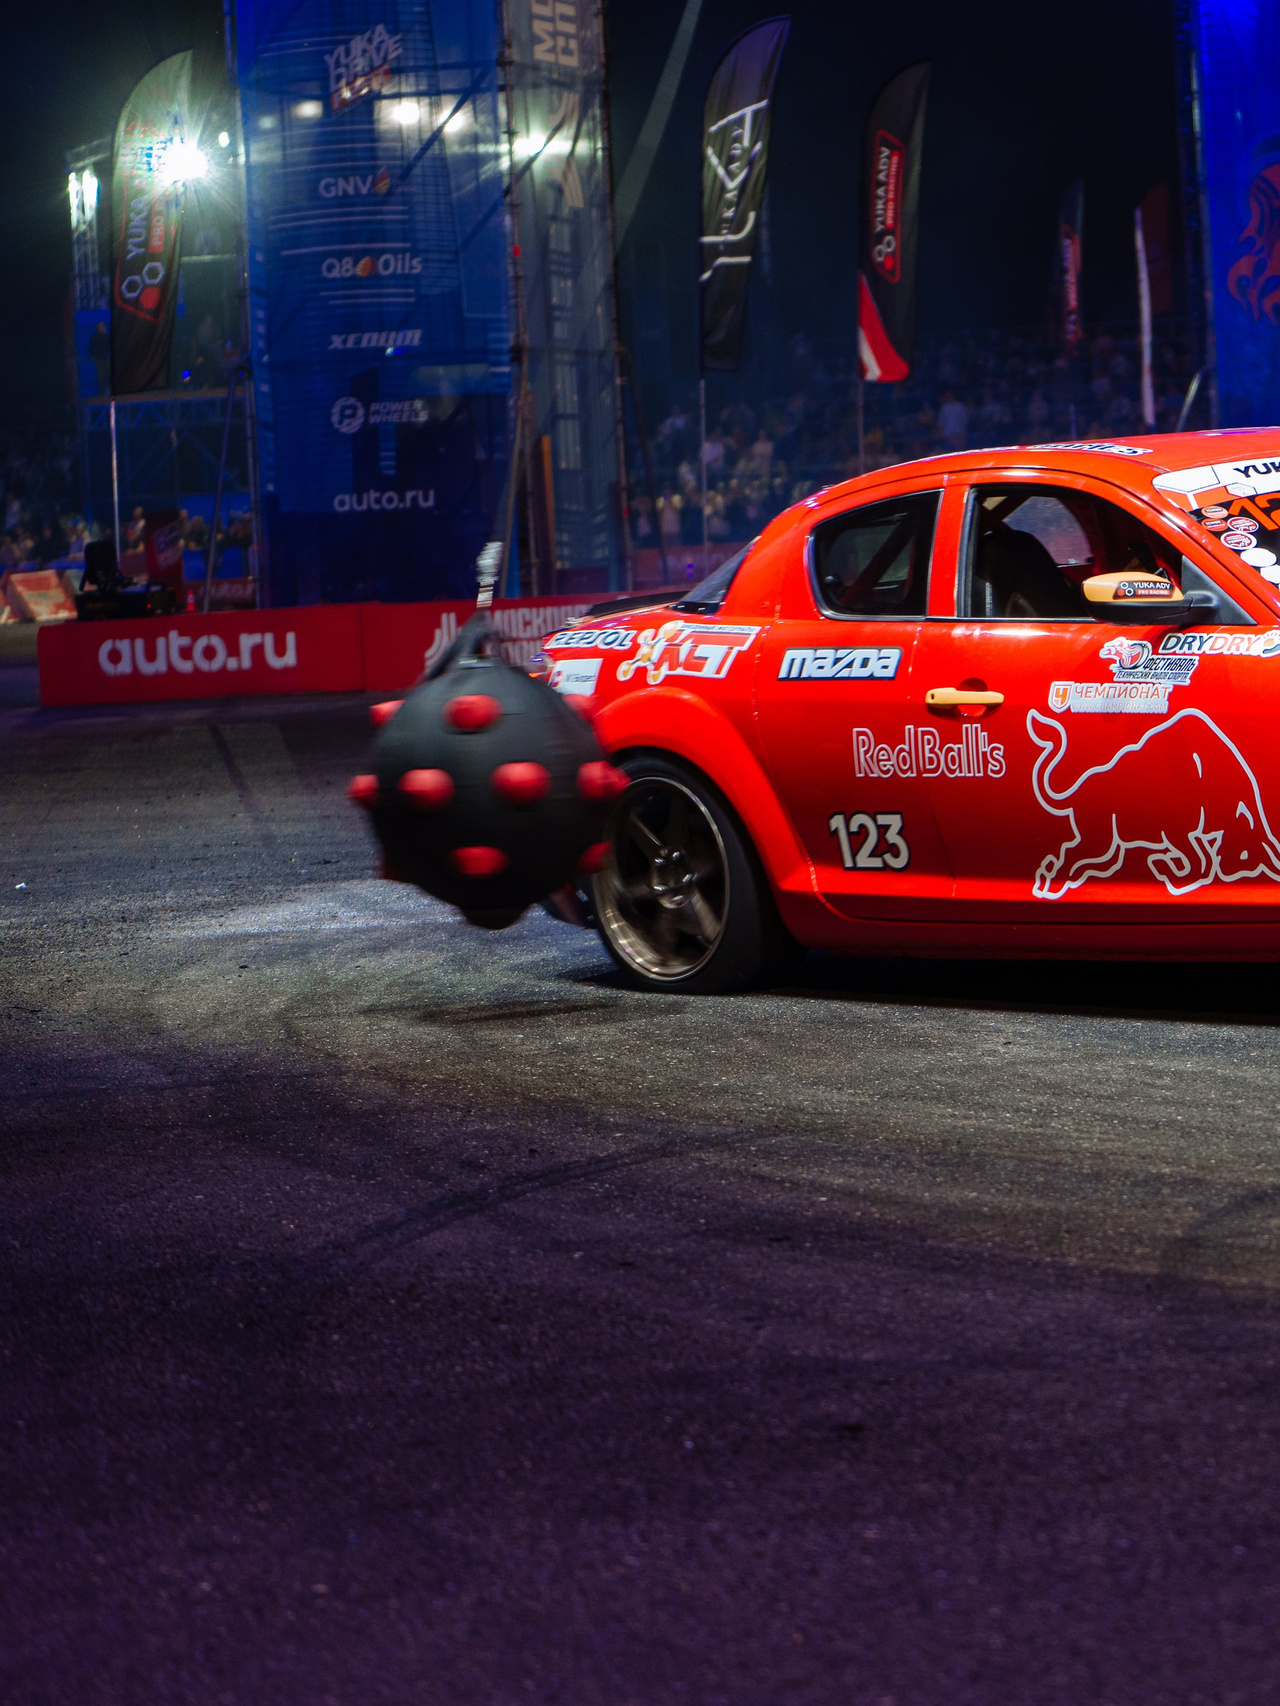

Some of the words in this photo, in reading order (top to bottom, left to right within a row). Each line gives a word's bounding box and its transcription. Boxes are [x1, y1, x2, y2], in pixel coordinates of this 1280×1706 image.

[877, 146, 891, 183] ADV
[318, 175, 374, 198] GNV
[874, 185, 887, 232] YUKA
[370, 400, 424, 412] POWER
[369, 410, 429, 424] WHEELS
[334, 488, 435, 512] auto.ru
[549, 629, 633, 649] REPSOL
[98, 629, 298, 677] auto.ru
[1142, 657, 1197, 672] ФЕСТИВАЛЬ
[1115, 671, 1151, 680] ТЕХНИЧЕСКИХ
[1150, 672, 1168, 680] ВИДОВ
[1074, 686, 1171, 699] ЧЕМПИОНАТ
[1072, 702, 1167, 710] WWW.CHAMPIONAT.COM
[852, 725, 917, 778] Red
[917, 723, 1006, 778] Ball's
[829, 813, 911, 870] 123
